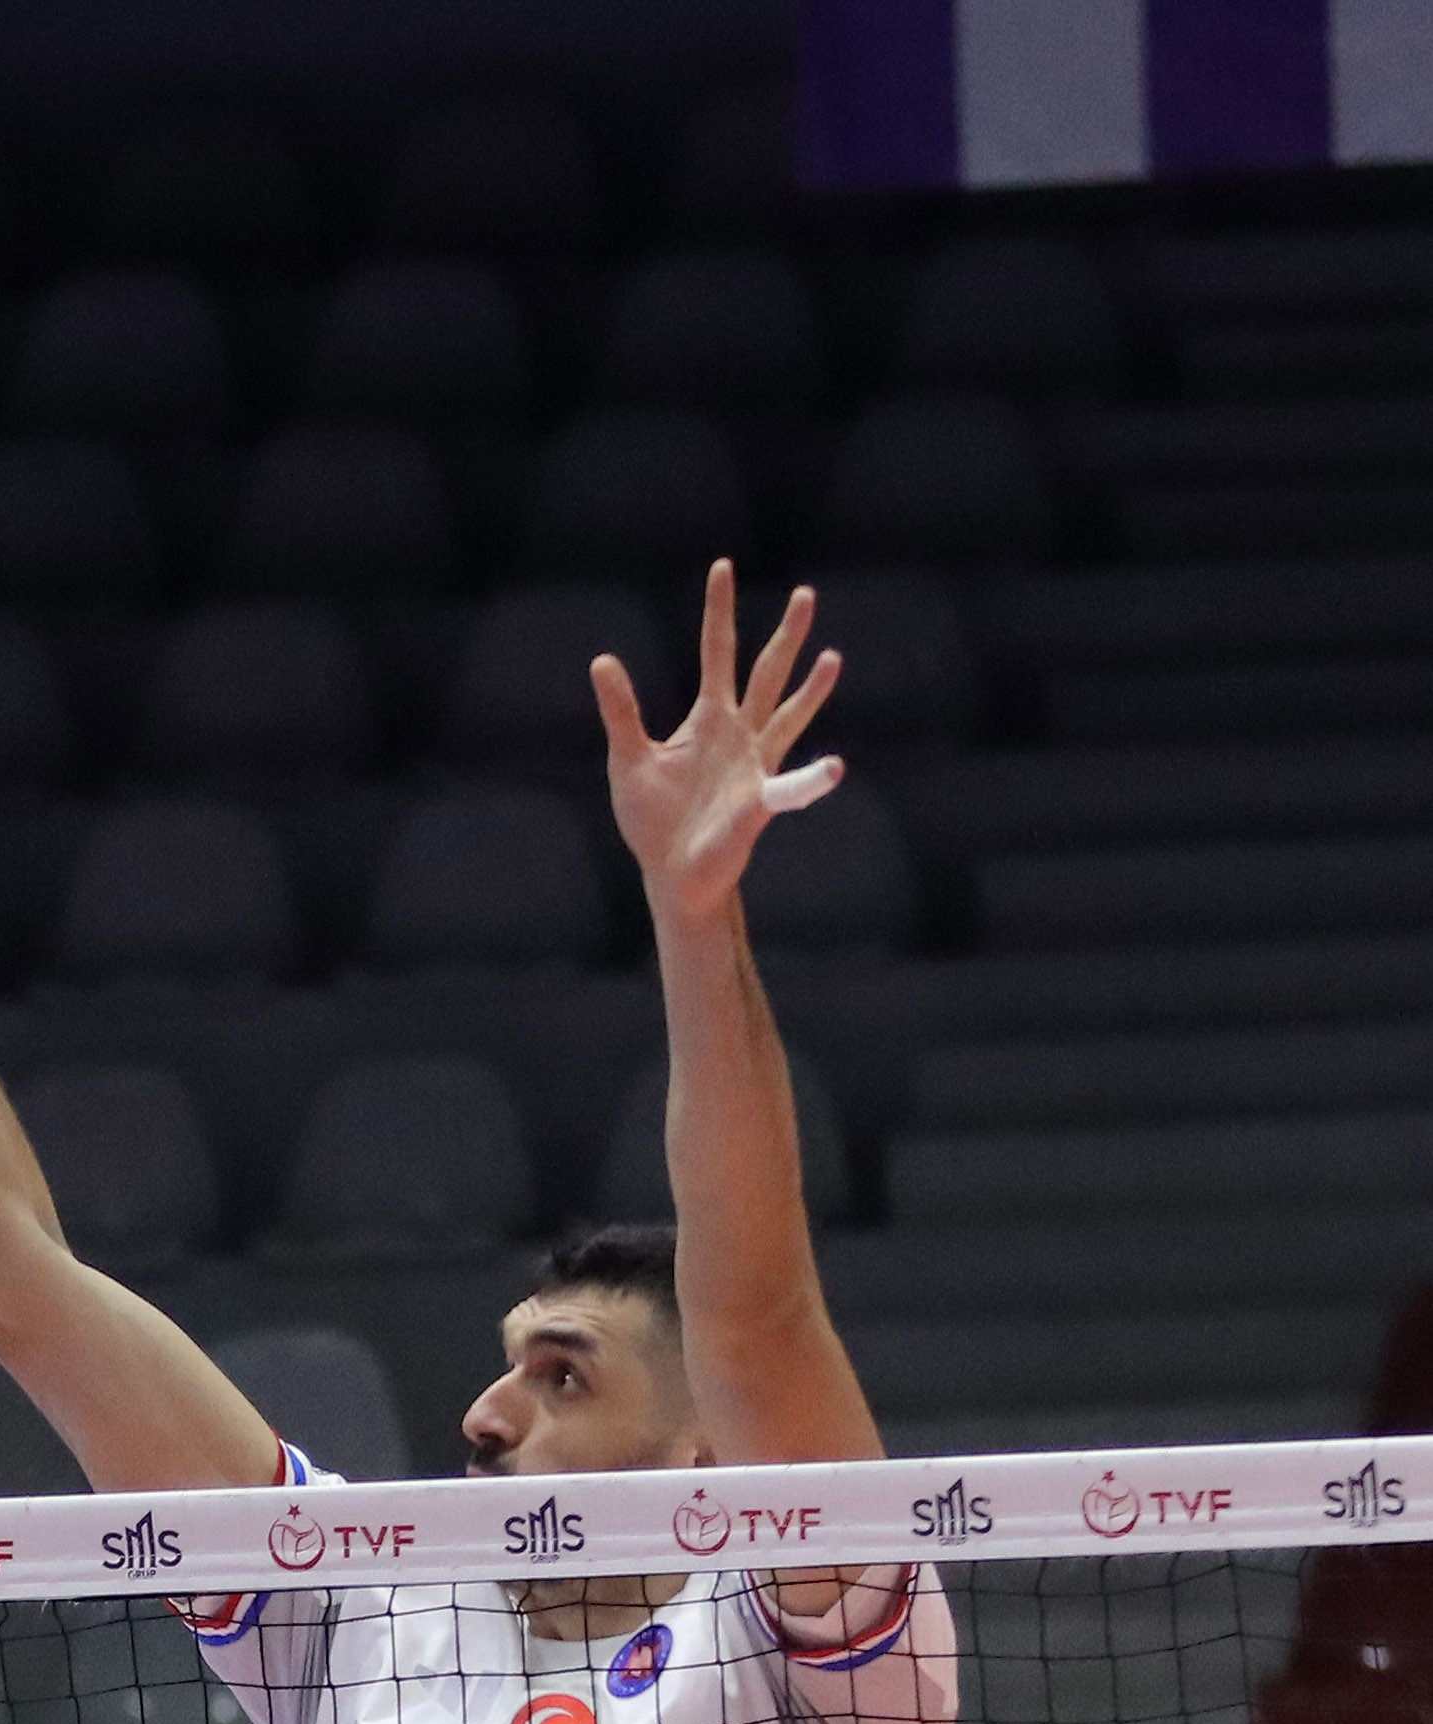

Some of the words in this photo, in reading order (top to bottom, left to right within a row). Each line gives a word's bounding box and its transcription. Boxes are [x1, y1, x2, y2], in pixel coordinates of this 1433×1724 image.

[912, 1477, 993, 1537] SMS
[1149, 1489, 1232, 1523] TVF
[1323, 1459, 1405, 1519] SMS
[102, 1510, 182, 1570] SMS
[333, 1525, 415, 1558] TVF
[504, 1495, 584, 1554] SMS
[740, 1507, 821, 1542] TVF
